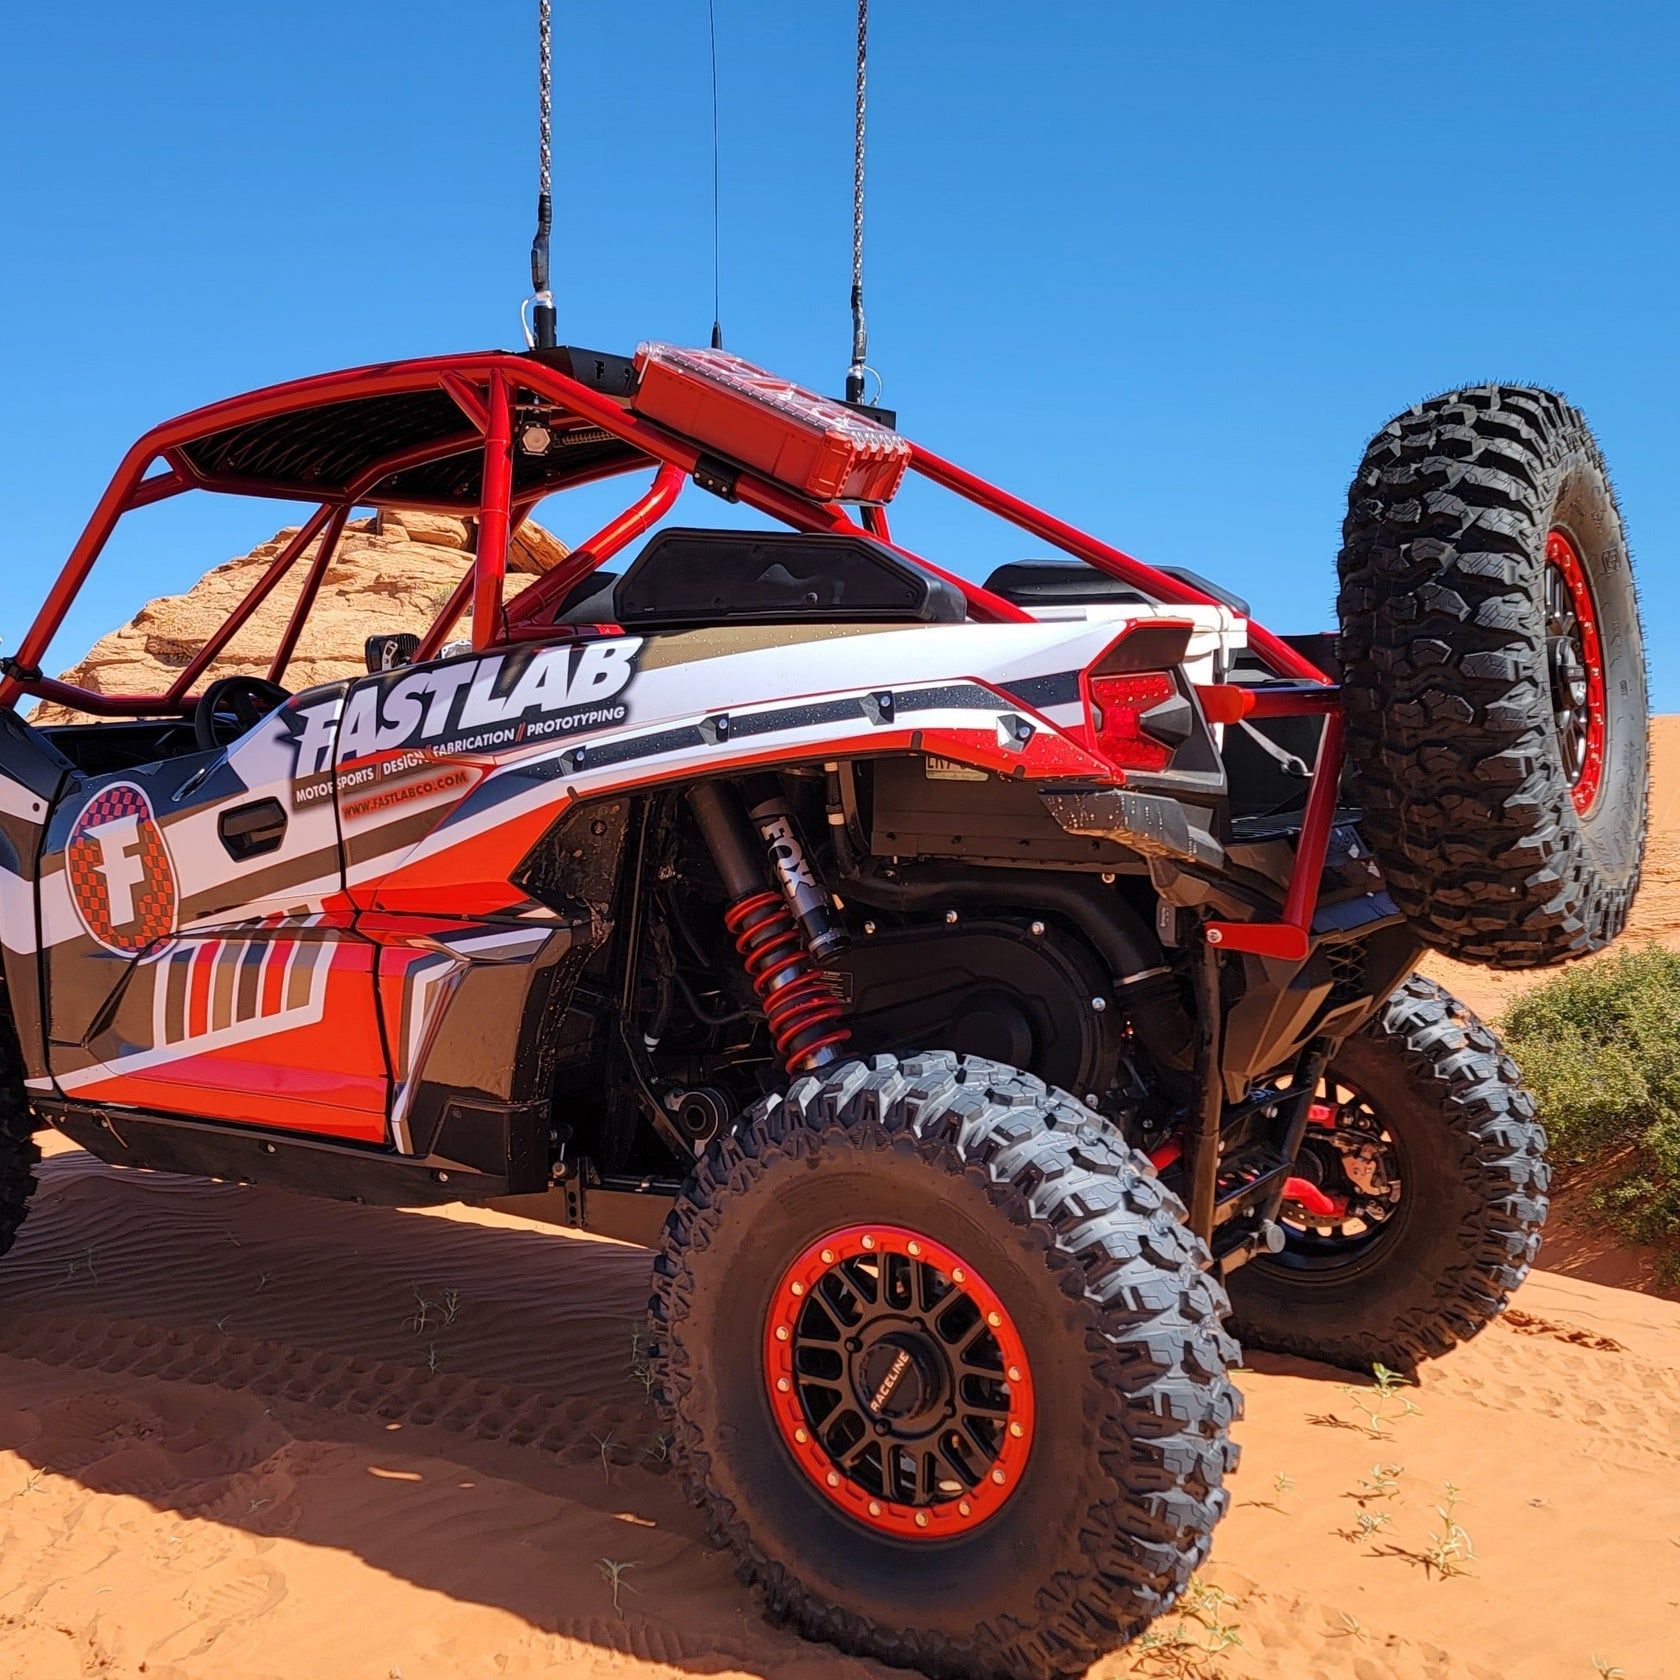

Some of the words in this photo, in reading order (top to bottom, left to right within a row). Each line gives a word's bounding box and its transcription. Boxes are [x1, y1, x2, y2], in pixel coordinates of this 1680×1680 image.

[293, 636, 644, 780] FASTLAB
[382, 751, 430, 775] DESIGN
[432, 728, 516, 758] FABRICATION
[526, 706, 626, 737] PROTOTYPING
[342, 772, 468, 819] WWW.FASTLABCO.COM
[82, 813, 145, 928] F
[760, 816, 817, 899] FOX
[870, 1350, 910, 1413] RACELINE
